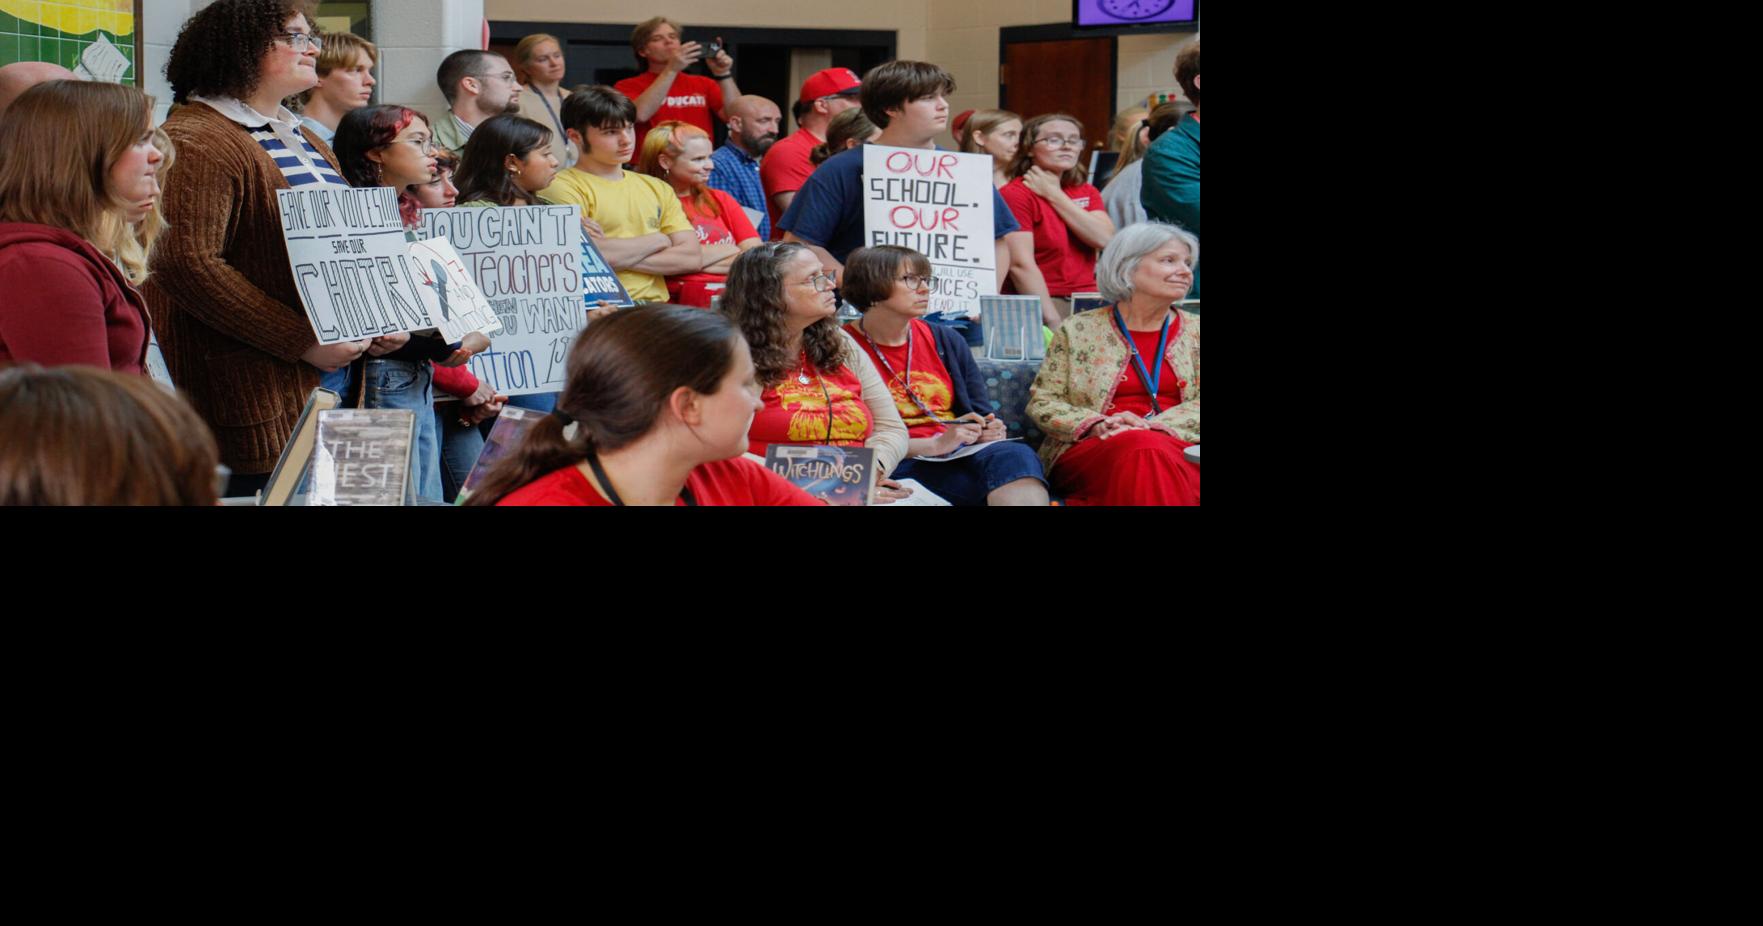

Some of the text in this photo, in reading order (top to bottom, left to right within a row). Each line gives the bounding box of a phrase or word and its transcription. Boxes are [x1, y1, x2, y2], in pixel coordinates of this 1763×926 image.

[886, 151, 958, 179] OUR
[870, 177, 979, 208] SCHOOL.
[280, 191, 311, 231] SAVE
[309, 190, 336, 229] OUR
[888, 205, 960, 231] OUR
[477, 206, 574, 249] CAN'T
[331, 238, 367, 254] SAVE OUR
[871, 230, 980, 263] FUTURE.
[462, 250, 578, 298] Teachers
[295, 254, 433, 342] CHOIR!
[520, 296, 584, 334] WANT
[468, 343, 539, 391] ation
[326, 440, 383, 459] THE
[772, 456, 864, 484] WITCHLINGS
